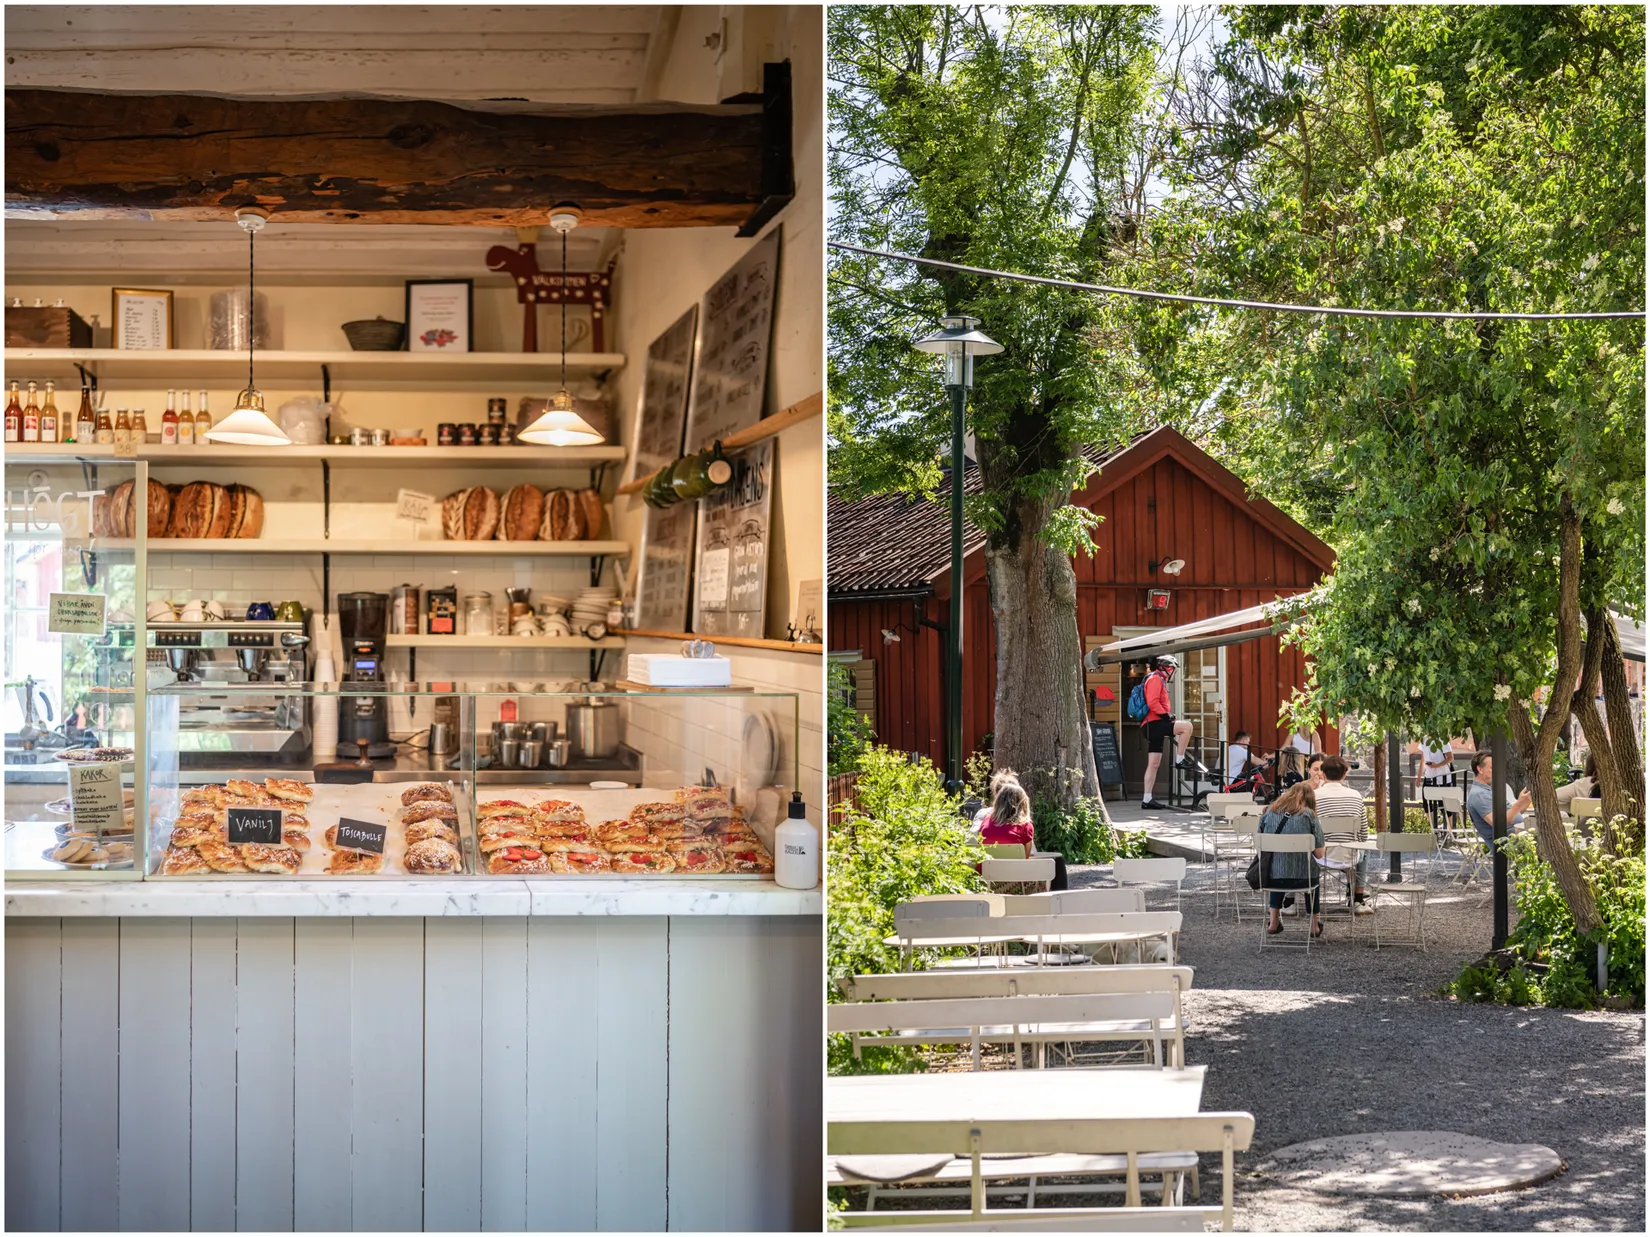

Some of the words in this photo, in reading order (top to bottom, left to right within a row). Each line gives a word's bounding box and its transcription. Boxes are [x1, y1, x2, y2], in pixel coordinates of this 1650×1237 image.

[80, 769, 108, 781] KAKOR
[235, 815, 274, 836] VANILJ
[340, 826, 383, 842] TOSCABULLE
